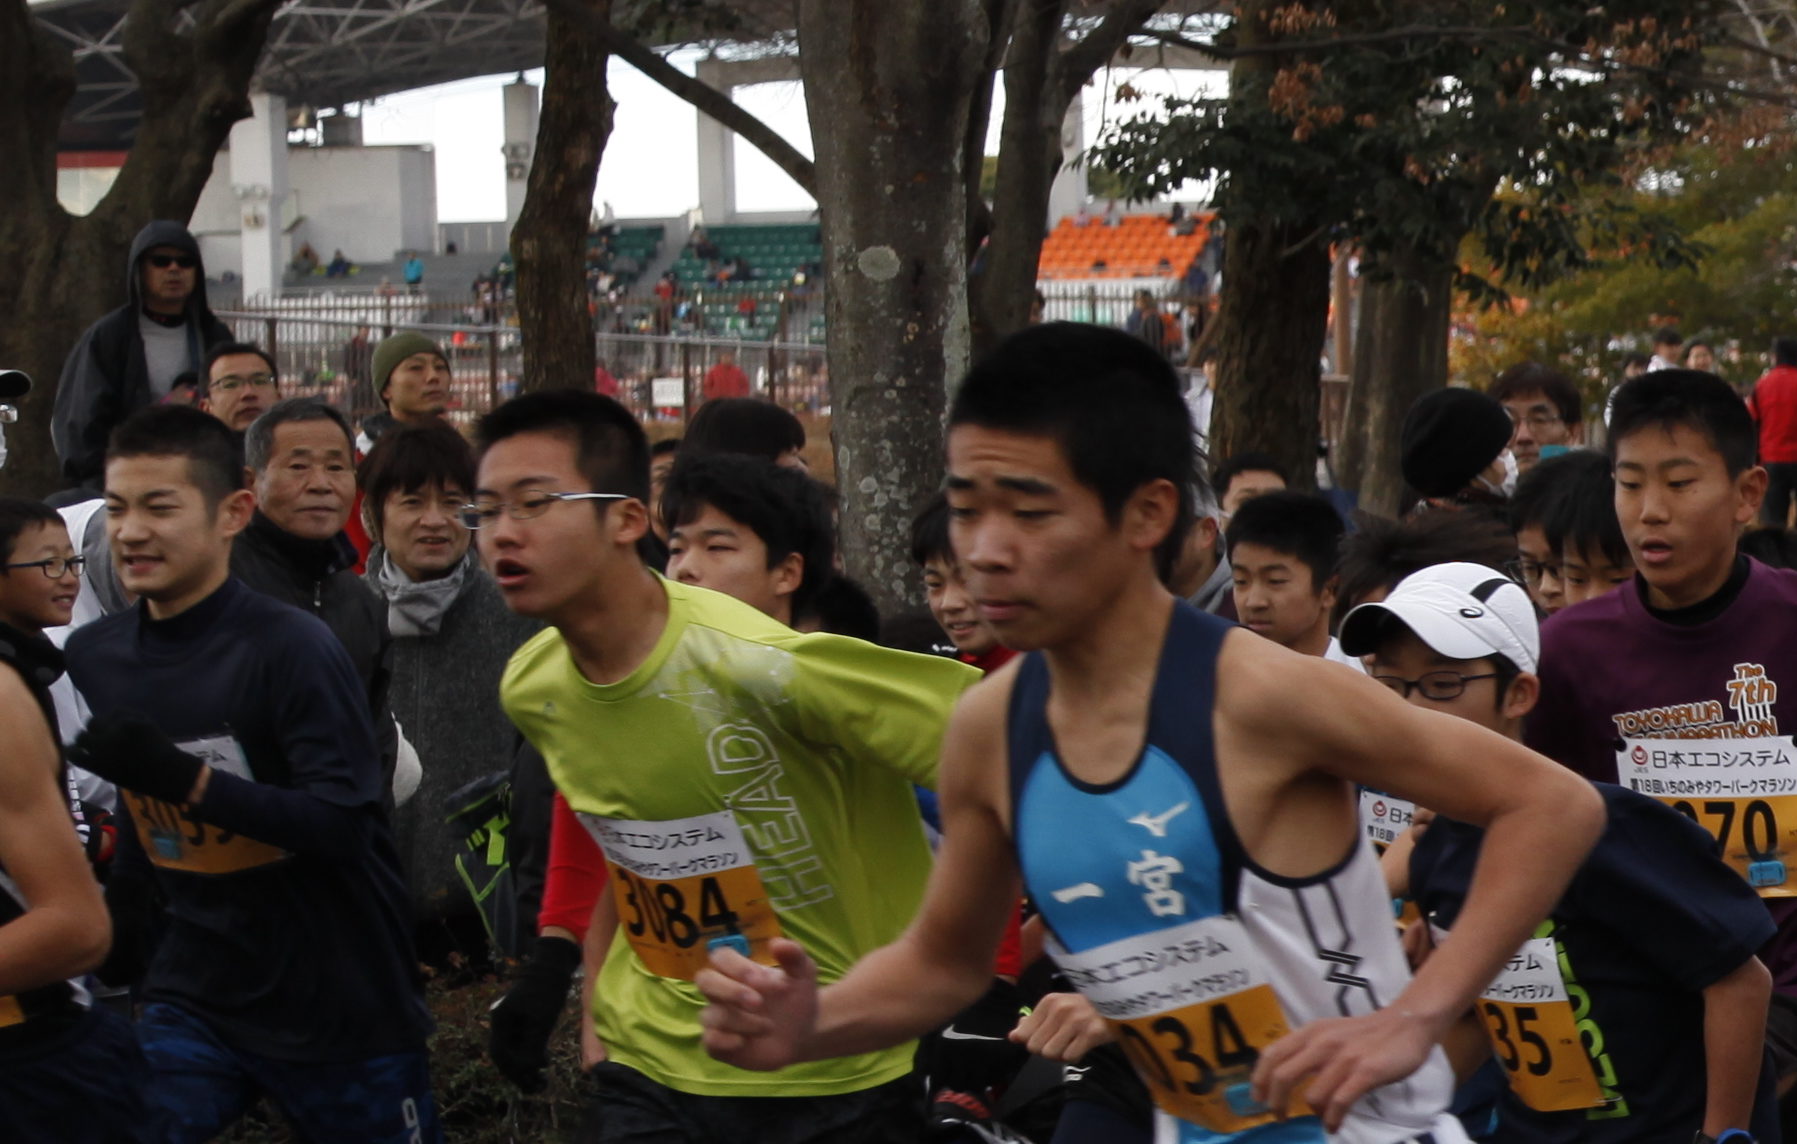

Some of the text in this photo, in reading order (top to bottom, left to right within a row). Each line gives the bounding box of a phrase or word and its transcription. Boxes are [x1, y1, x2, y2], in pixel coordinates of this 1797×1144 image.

[1613, 700, 1724, 734] TOYOKAWA
[1727, 677, 1777, 709] 7th
[1652, 749, 1791, 770] 日本エコシステム
[706, 723, 834, 913] HEAD
[617, 867, 738, 948] 3084
[1050, 850, 1187, 919] 一宮
